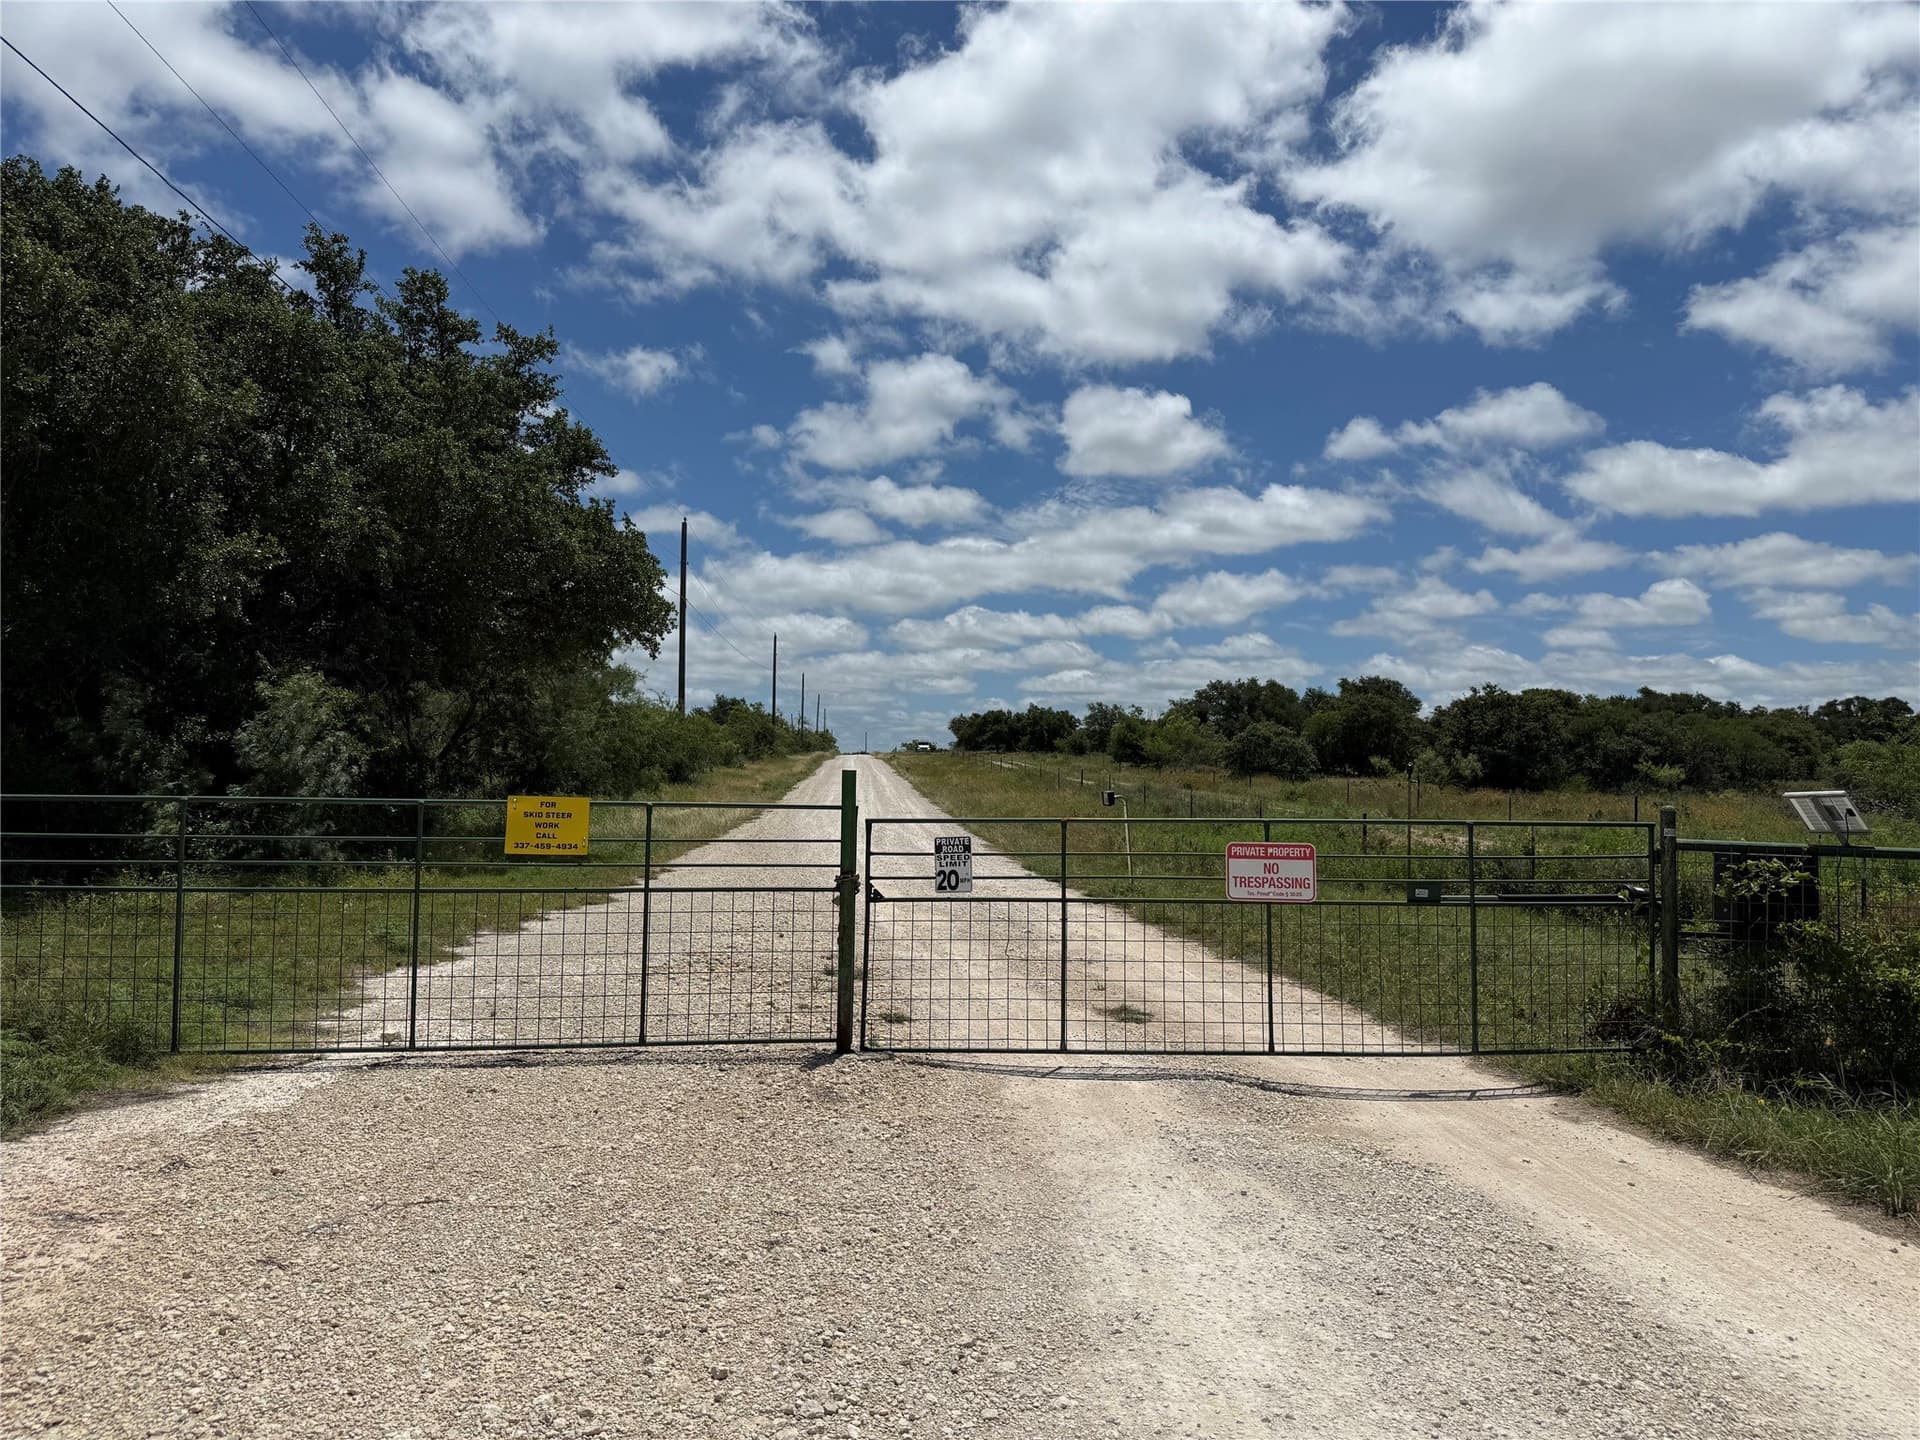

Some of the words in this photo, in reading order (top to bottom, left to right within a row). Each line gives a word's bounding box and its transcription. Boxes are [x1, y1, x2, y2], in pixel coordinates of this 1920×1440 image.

[523, 811, 543, 819] SKID
[936, 837, 969, 846] PRIVATE
[942, 845, 964, 853] ROAD
[1231, 846, 1265, 856] PRIVATE
[1267, 847, 1311, 857] PROPERTY
[1263, 862, 1280, 875] NO
[936, 869, 960, 891] 20
[1232, 876, 1311, 890] TRESPASSING
